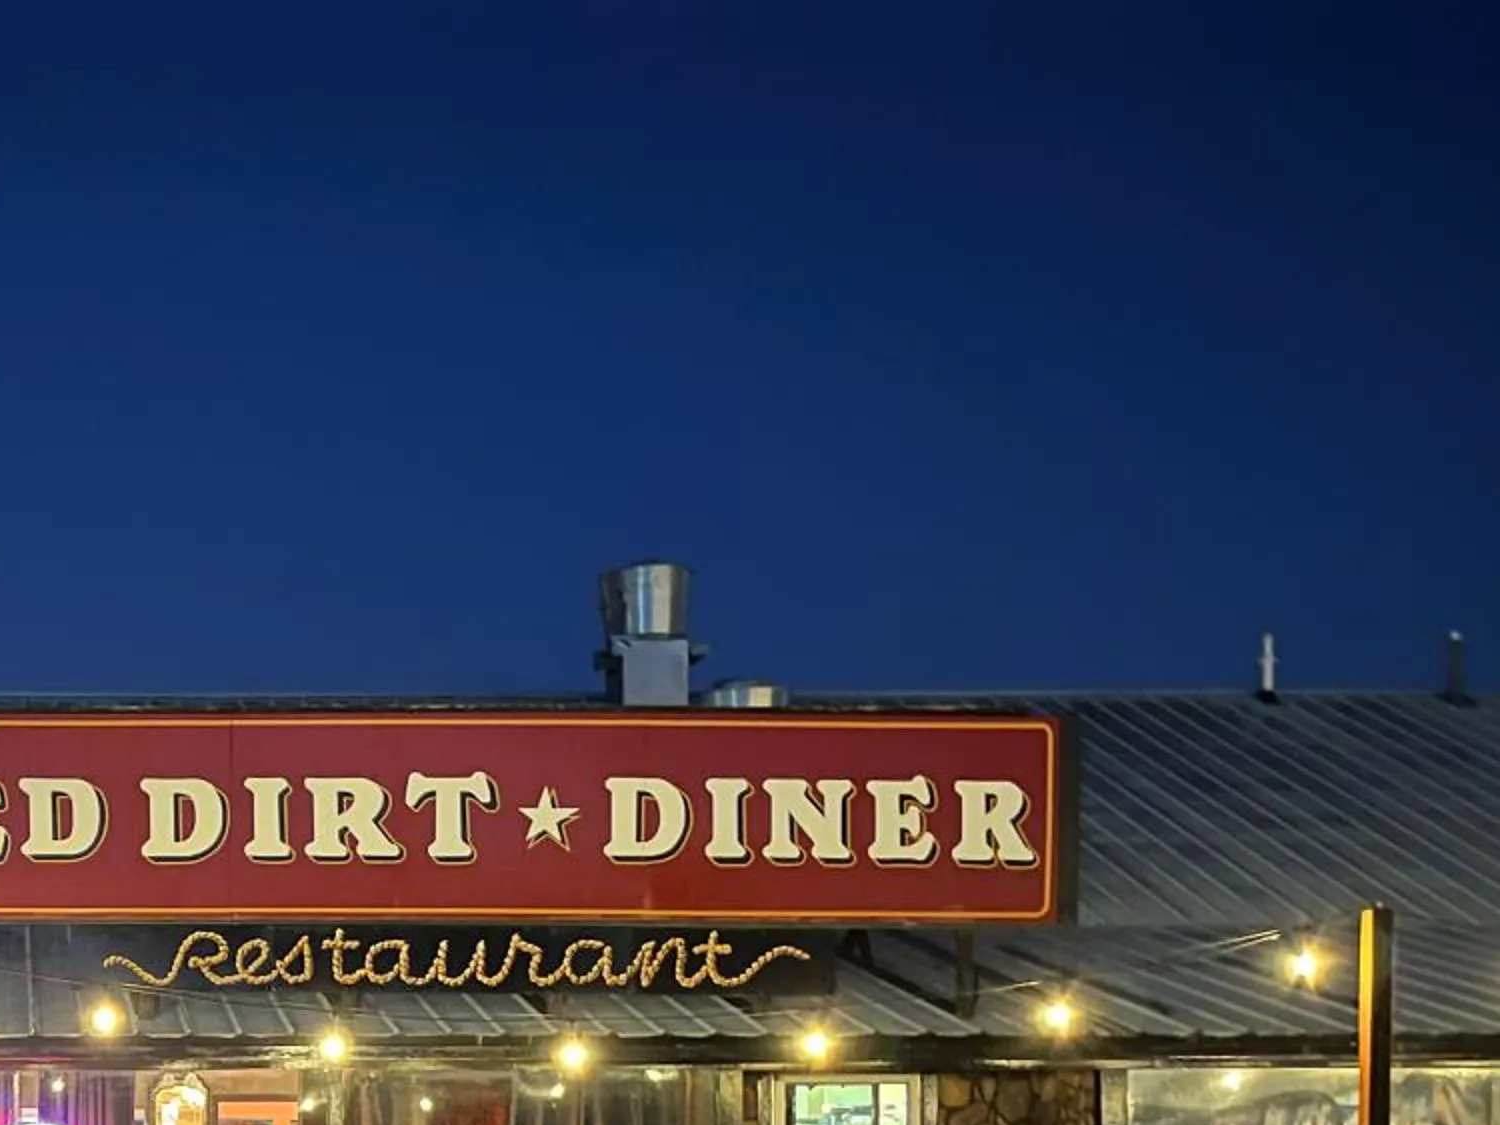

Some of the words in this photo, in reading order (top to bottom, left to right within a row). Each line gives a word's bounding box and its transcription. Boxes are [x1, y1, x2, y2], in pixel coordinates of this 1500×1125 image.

[139, 772, 498, 864] DIRT
[603, 775, 1038, 867] DINER
[103, 928, 811, 988] Restaurant
